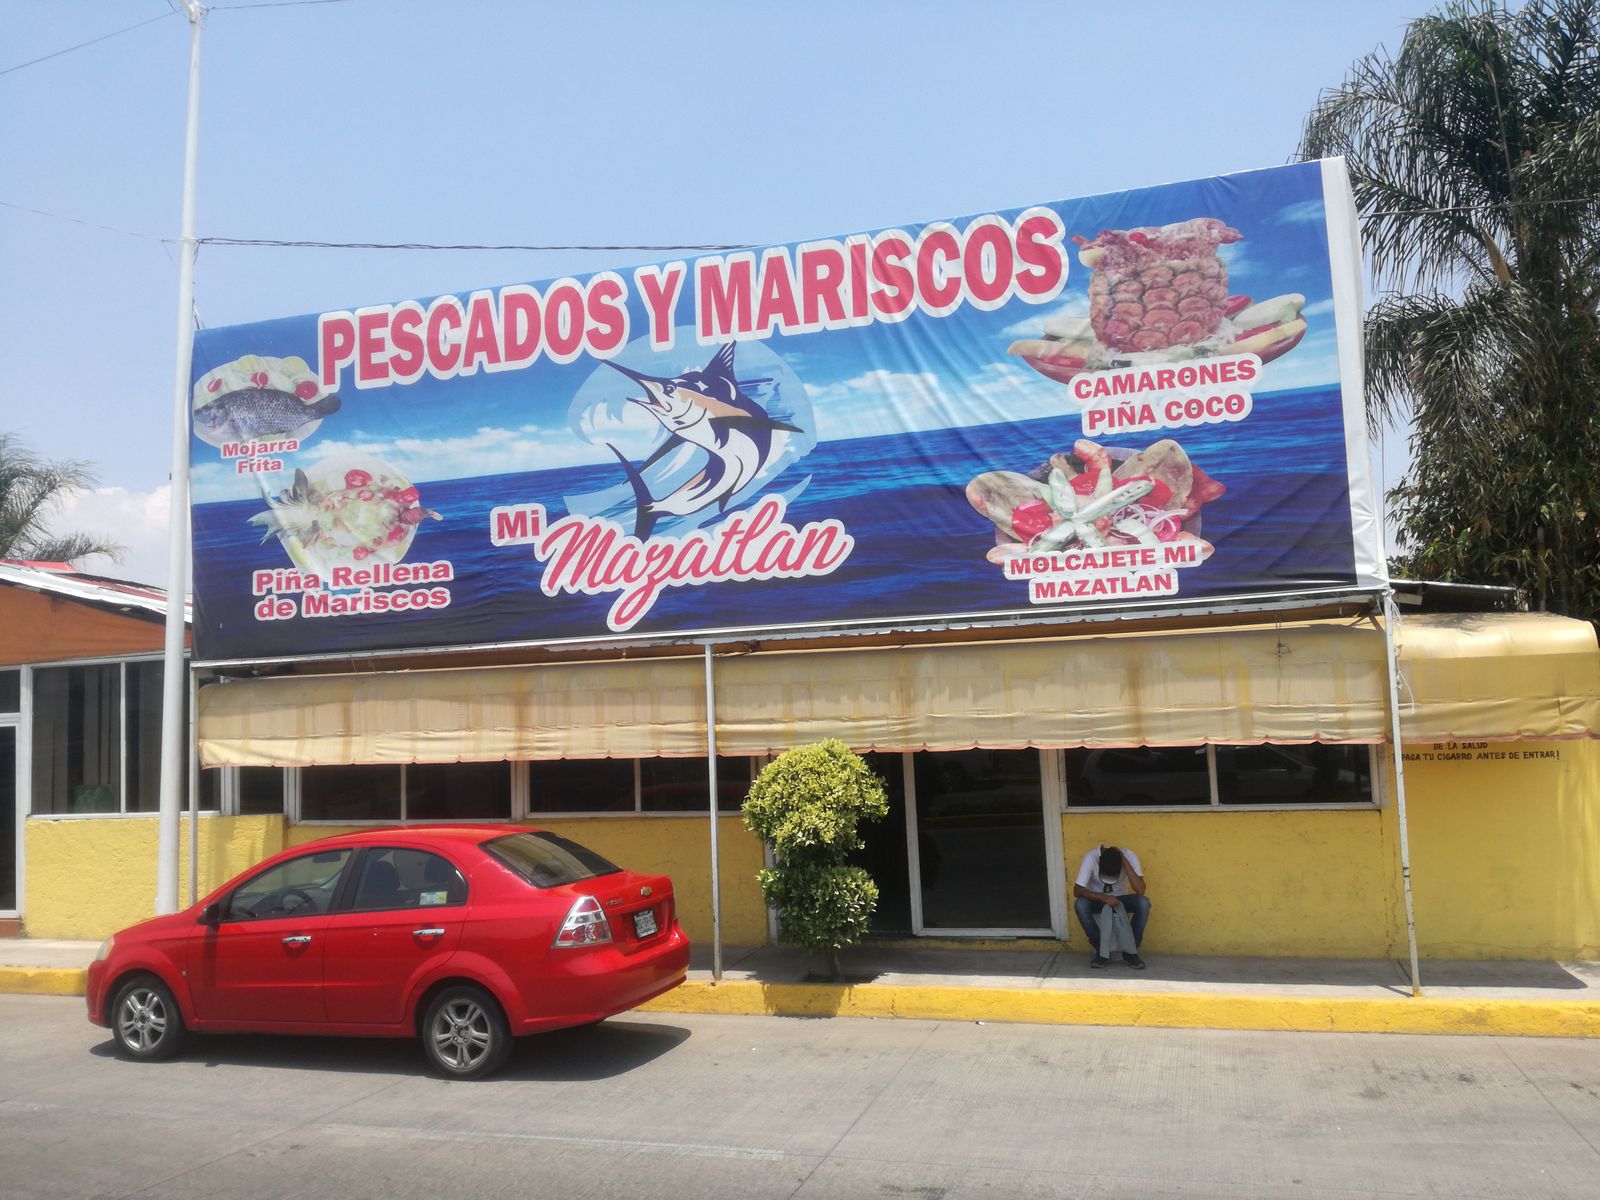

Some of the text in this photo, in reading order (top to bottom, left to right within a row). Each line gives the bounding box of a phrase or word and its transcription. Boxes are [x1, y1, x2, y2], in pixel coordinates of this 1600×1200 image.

[321, 216, 1063, 386] PESCADOS Y MARISCOS
[1074, 359, 1256, 399] CAMARONES
[1088, 394, 1245, 430] PIÑA COCO
[222, 440, 298, 457] Mojarra
[237, 458, 282, 474] Frita
[497, 501, 847, 626] Mi Mazatlan
[1010, 545, 1196, 575] MOLCAJETE MI
[255, 563, 450, 593] Piña Rellena
[1035, 573, 1172, 599] MAZATLAN
[257, 589, 449, 618] de Mariscos
[1437, 752, 1472, 761] CIGARRO
[1477, 752, 1506, 760] ANTES
[1509, 751, 1520, 760] DE
[1523, 750, 1560, 760] ENTRAR!
[1447, 742, 1458, 750] LA
[1462, 741, 1488, 749] SALUD
